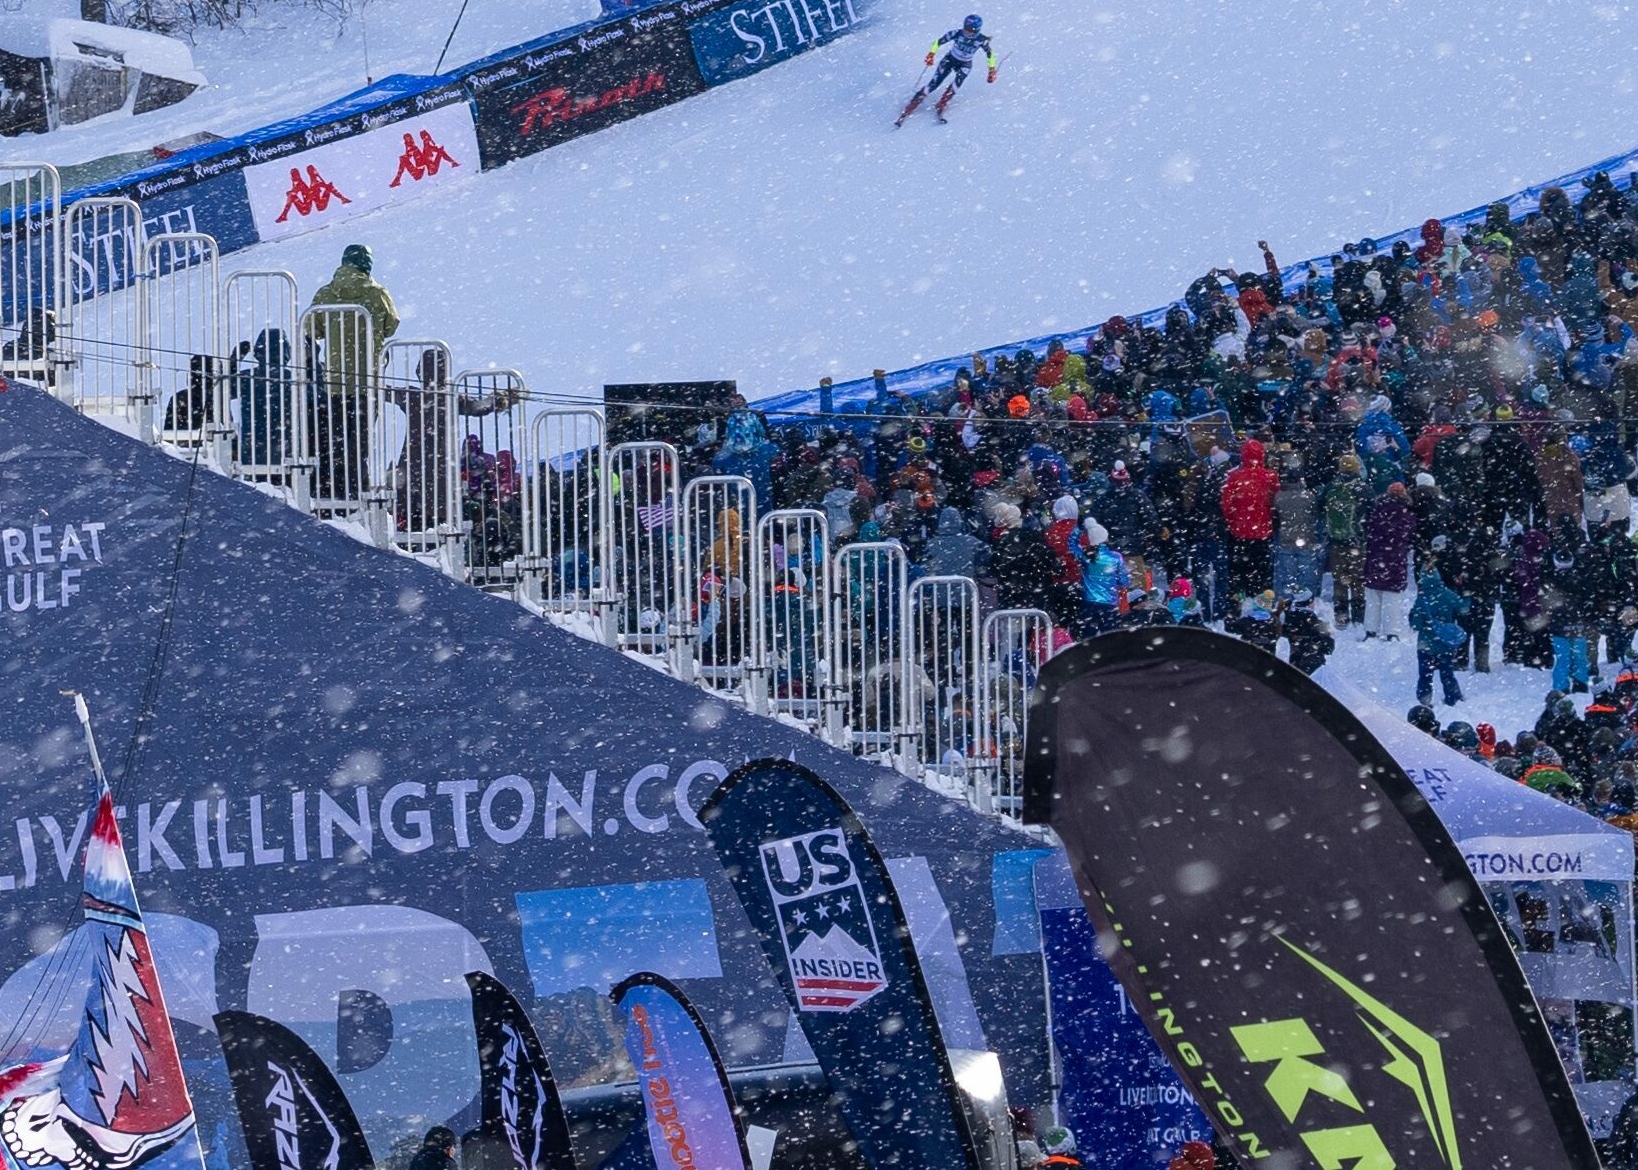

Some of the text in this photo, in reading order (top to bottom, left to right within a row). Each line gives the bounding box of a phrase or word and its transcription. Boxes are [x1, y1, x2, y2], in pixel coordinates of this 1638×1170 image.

[479, 67, 519, 88] Hydro Flask
[424, 89, 463, 110] Hydro Flask
[313, 123, 354, 144] Hydro Flask
[257, 140, 296, 160] Hydro Flask
[202, 155, 242, 177] Hydro Flask
[147, 175, 186, 195] Hydro Flask
[762, 833, 853, 898] US
[791, 956, 883, 981] INSIDER
